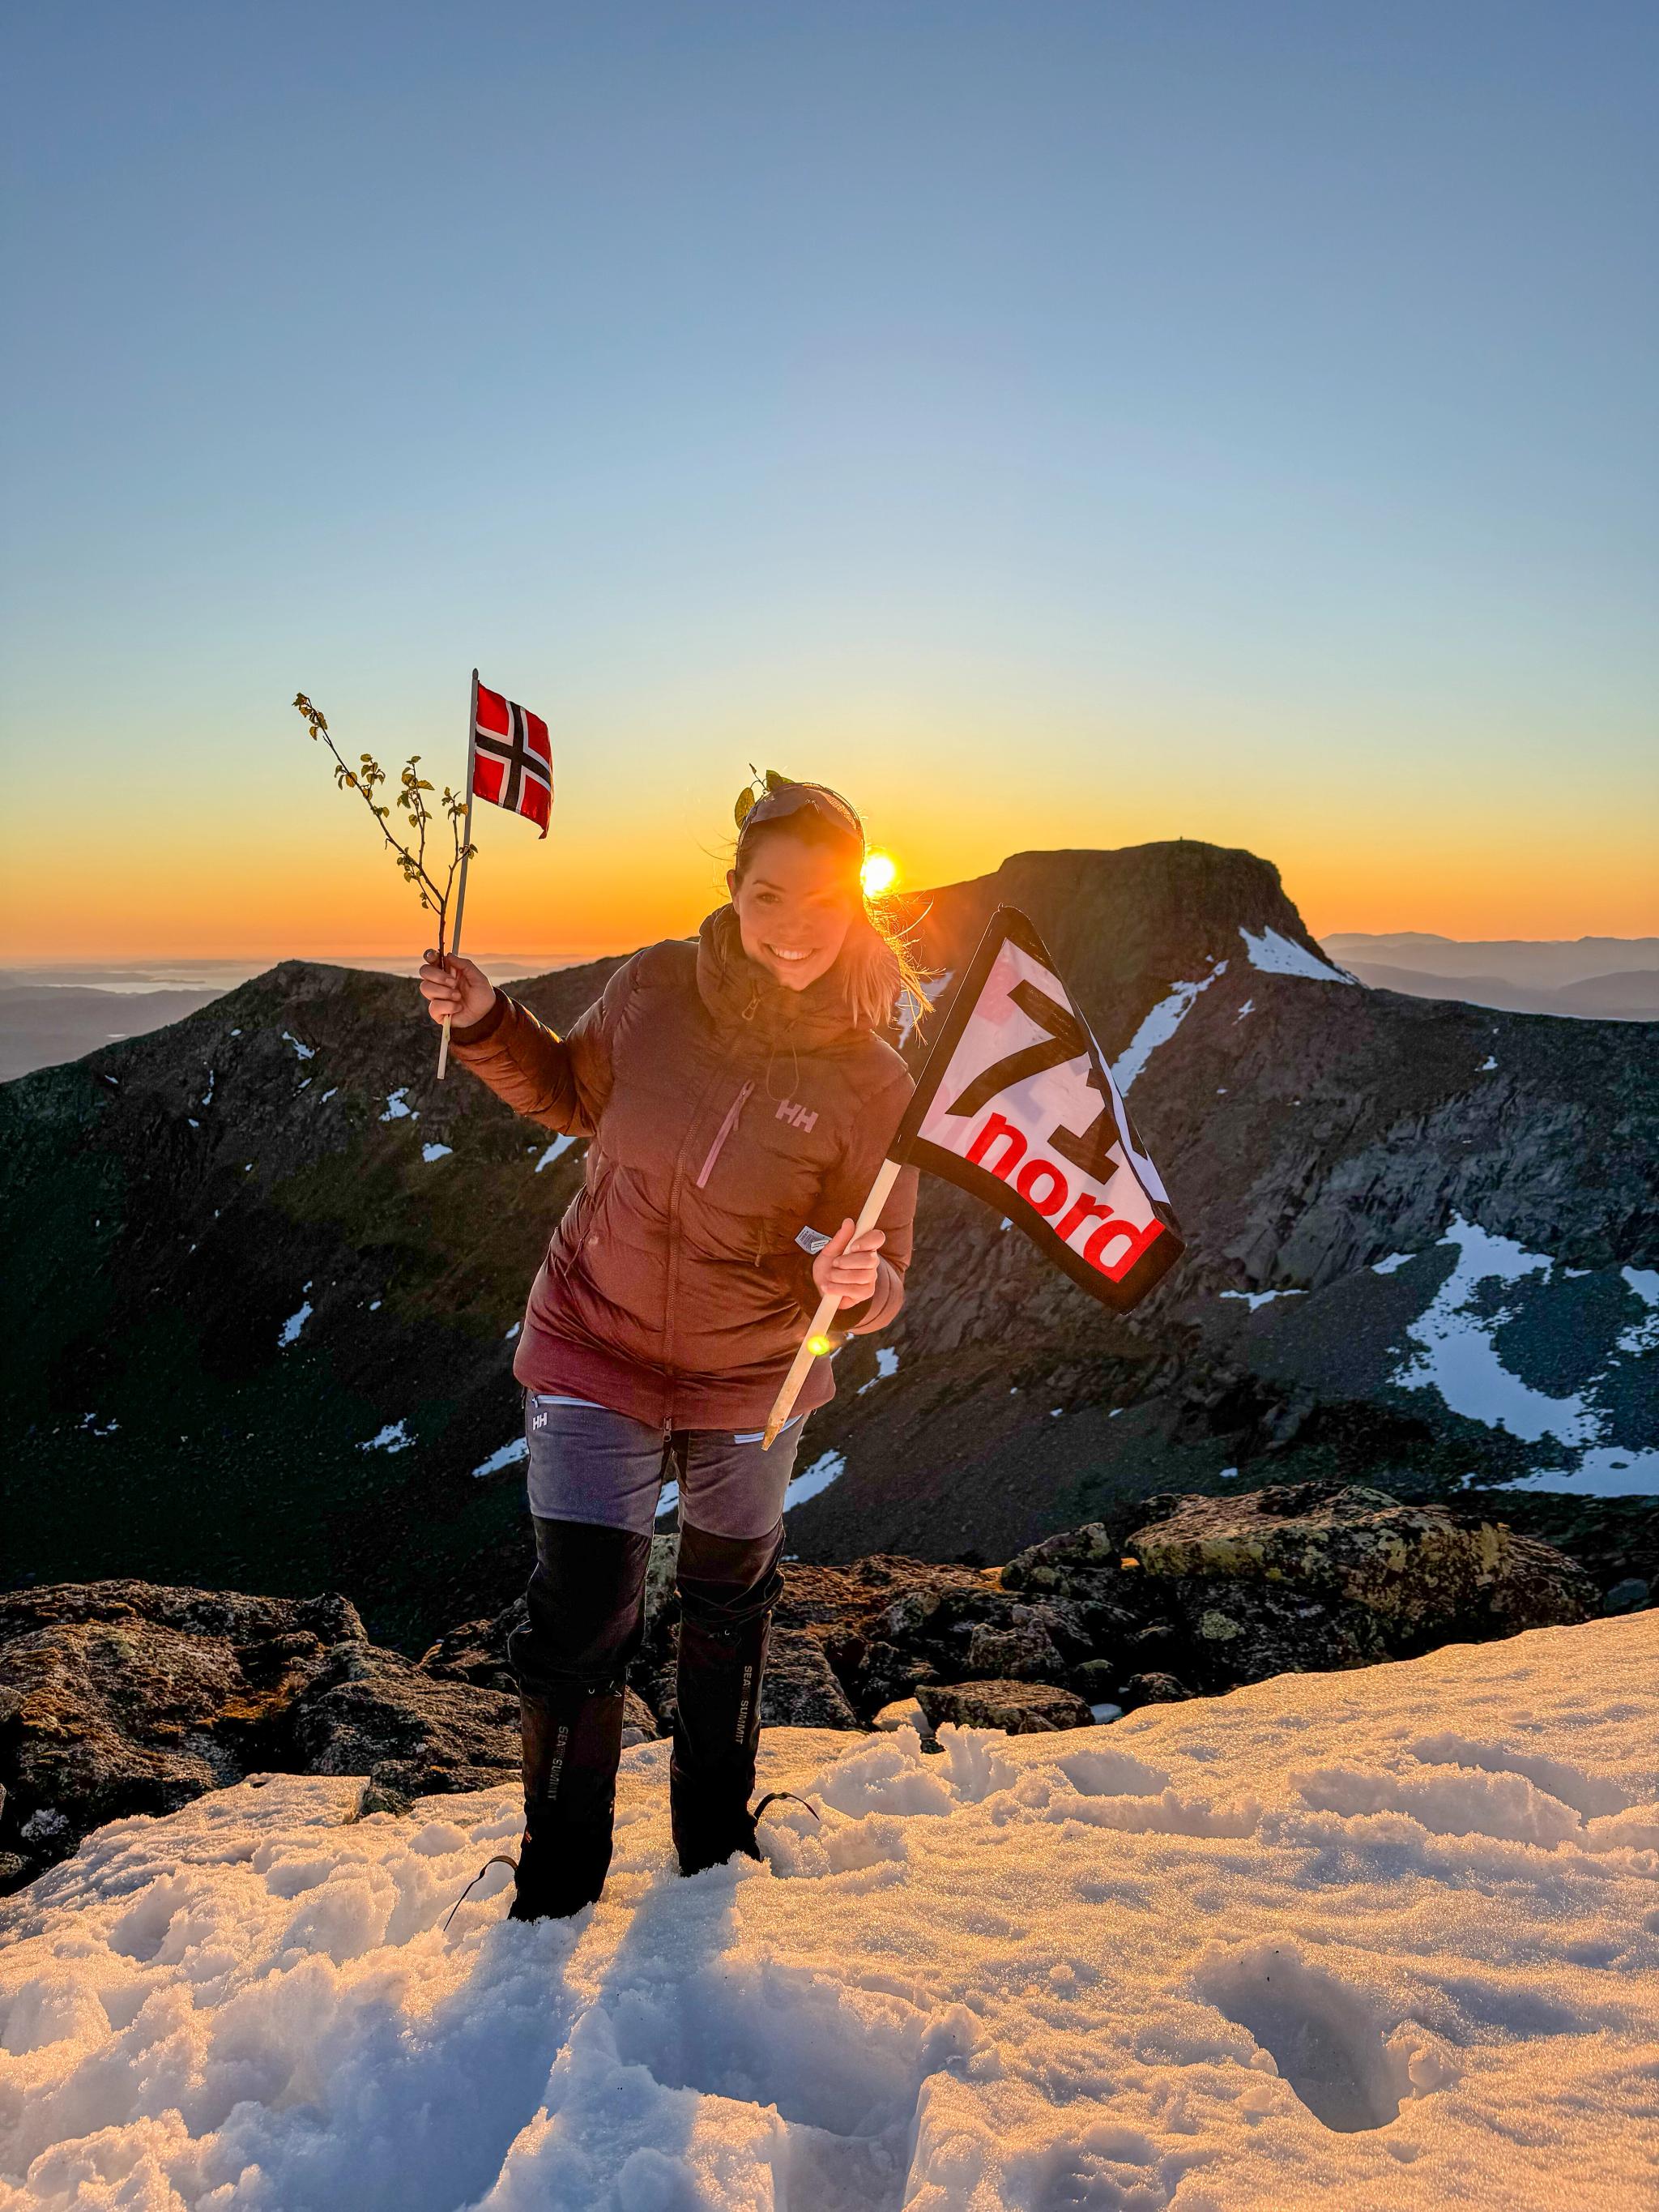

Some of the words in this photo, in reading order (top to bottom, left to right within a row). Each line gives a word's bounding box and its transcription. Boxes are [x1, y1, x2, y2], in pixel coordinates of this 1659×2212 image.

[774, 1099, 820, 1134] HH
[966, 1112, 1166, 1283] nord
[532, 1412, 548, 1431] HH
